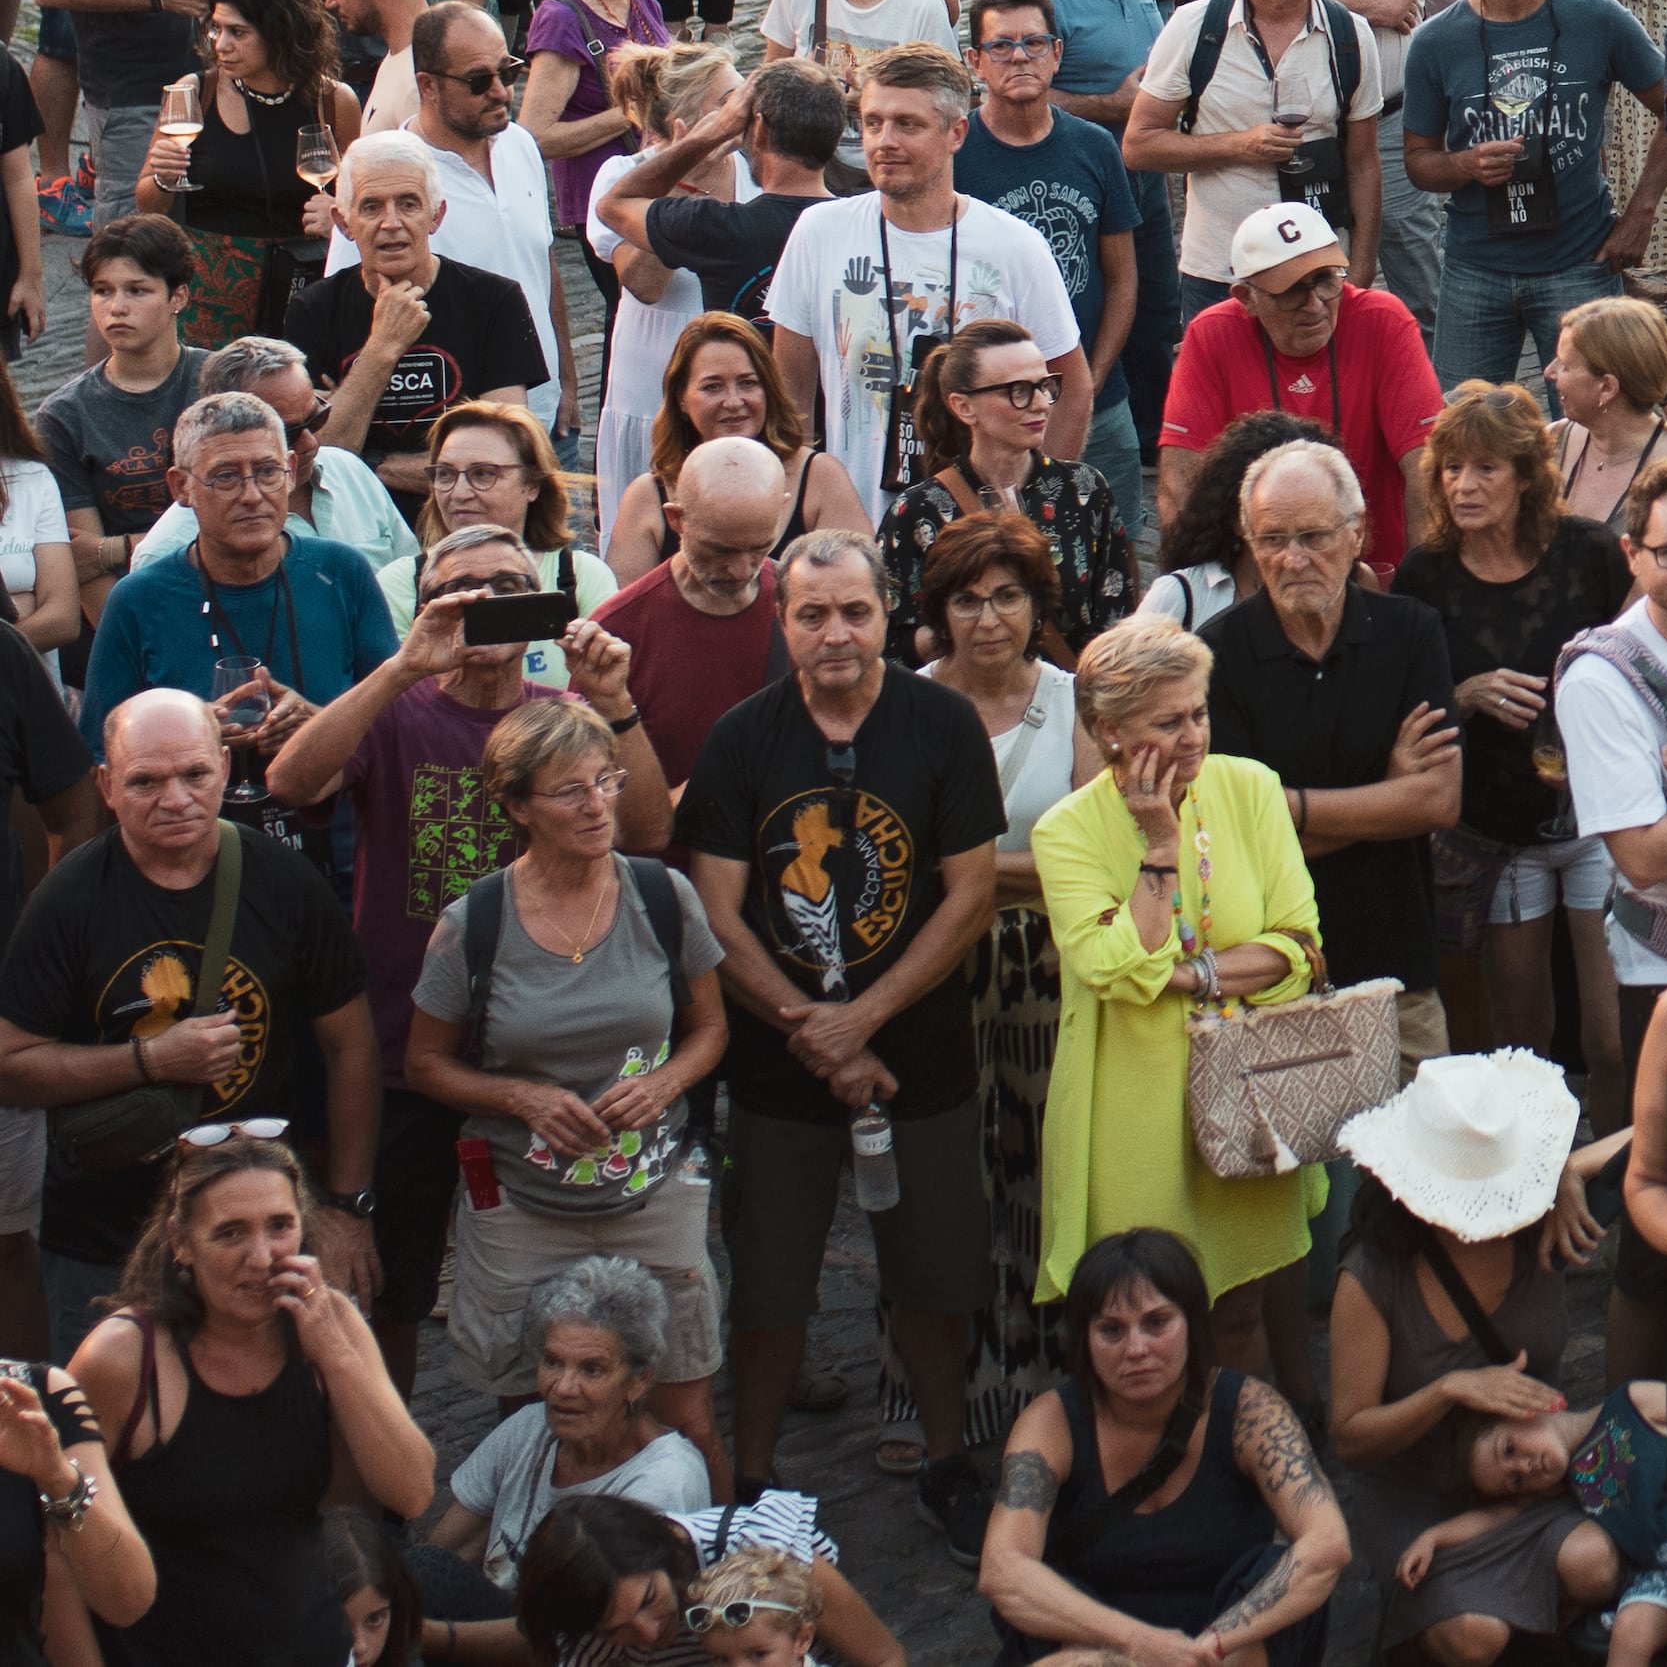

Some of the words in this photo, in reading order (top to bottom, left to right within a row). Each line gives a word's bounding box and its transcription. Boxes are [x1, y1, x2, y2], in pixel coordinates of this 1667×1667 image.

[1304, 182, 1330, 197] MON
[1507, 183, 1535, 197] MON
[1508, 196, 1524, 209] TA
[1510, 210, 1527, 224] NO
[1277, 219, 1302, 244] C
[291, 277, 305, 290] SO
[899, 423, 913, 439] SO
[898, 438, 926, 455] MON
[263, 820, 286, 838] SO
[851, 795, 910, 949] ESCUCHA
